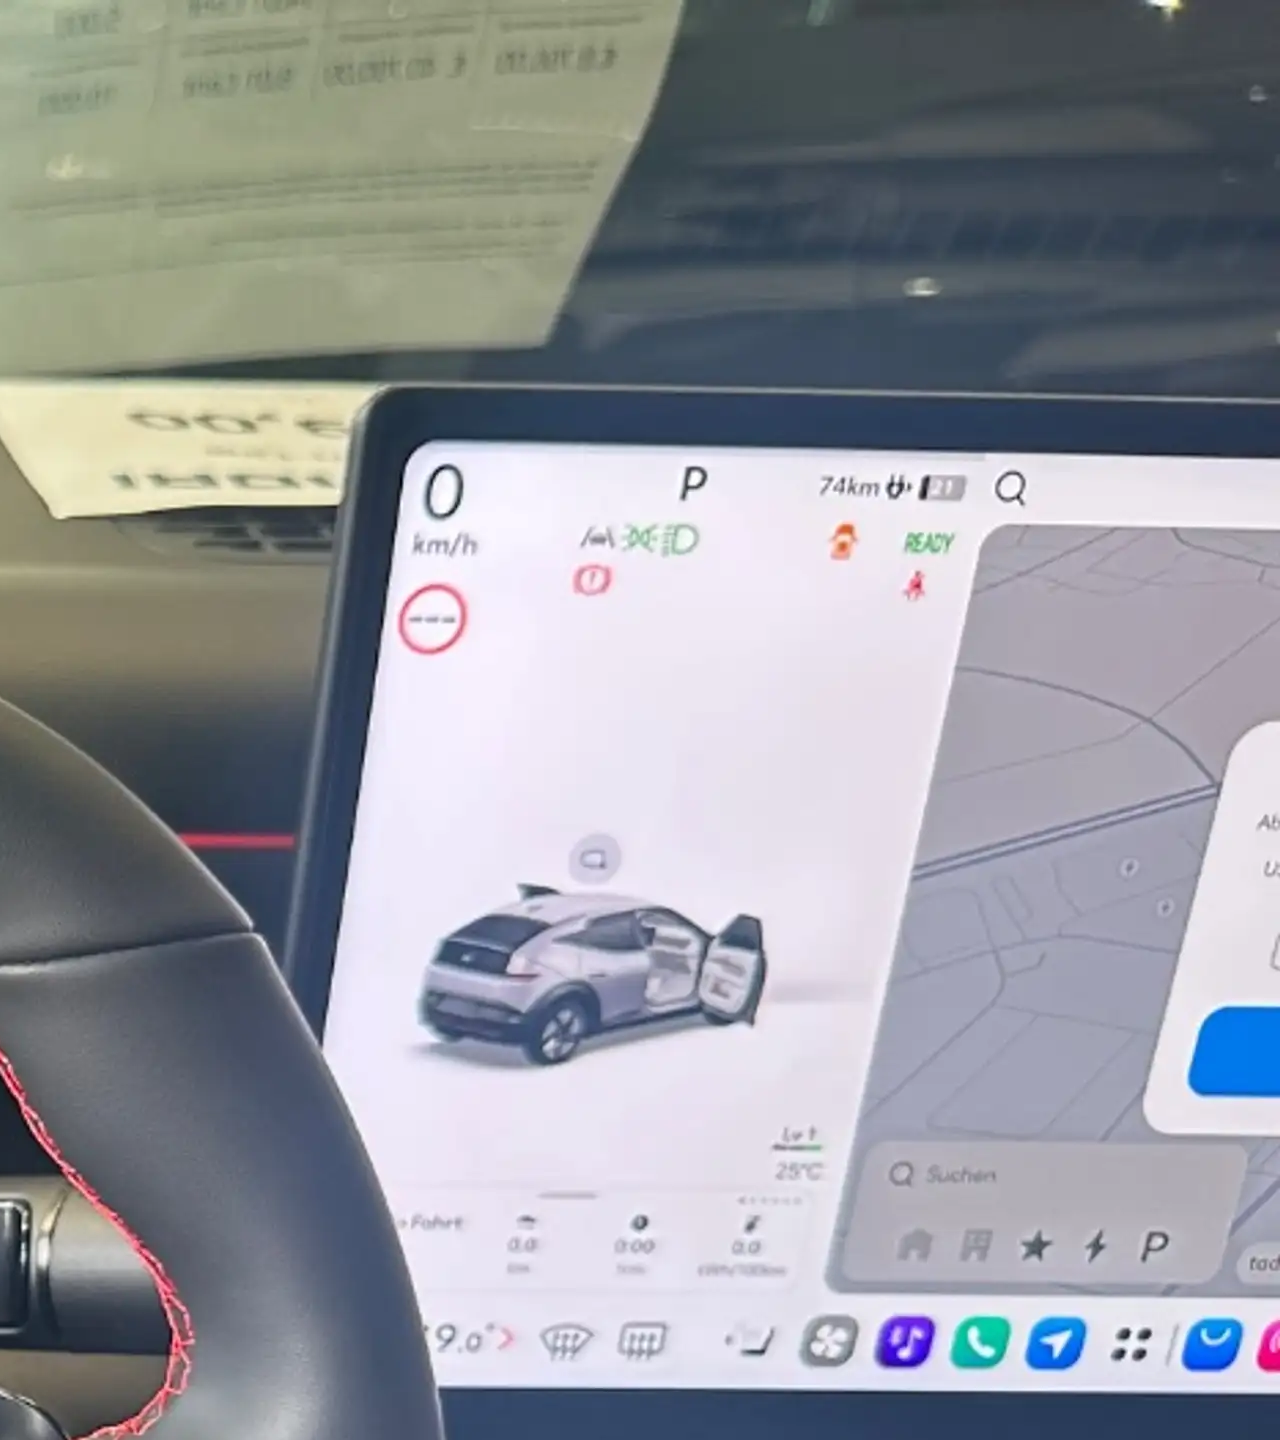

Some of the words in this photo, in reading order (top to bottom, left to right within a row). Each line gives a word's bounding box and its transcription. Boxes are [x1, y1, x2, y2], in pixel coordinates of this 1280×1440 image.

[424, 463, 464, 521] 0
[679, 466, 707, 501] P
[819, 475, 880, 498] 74km
[411, 532, 478, 558] km/h
[903, 531, 956, 554] READY
[926, 1164, 997, 1185] Suchen
[1140, 1230, 1170, 1264] P
